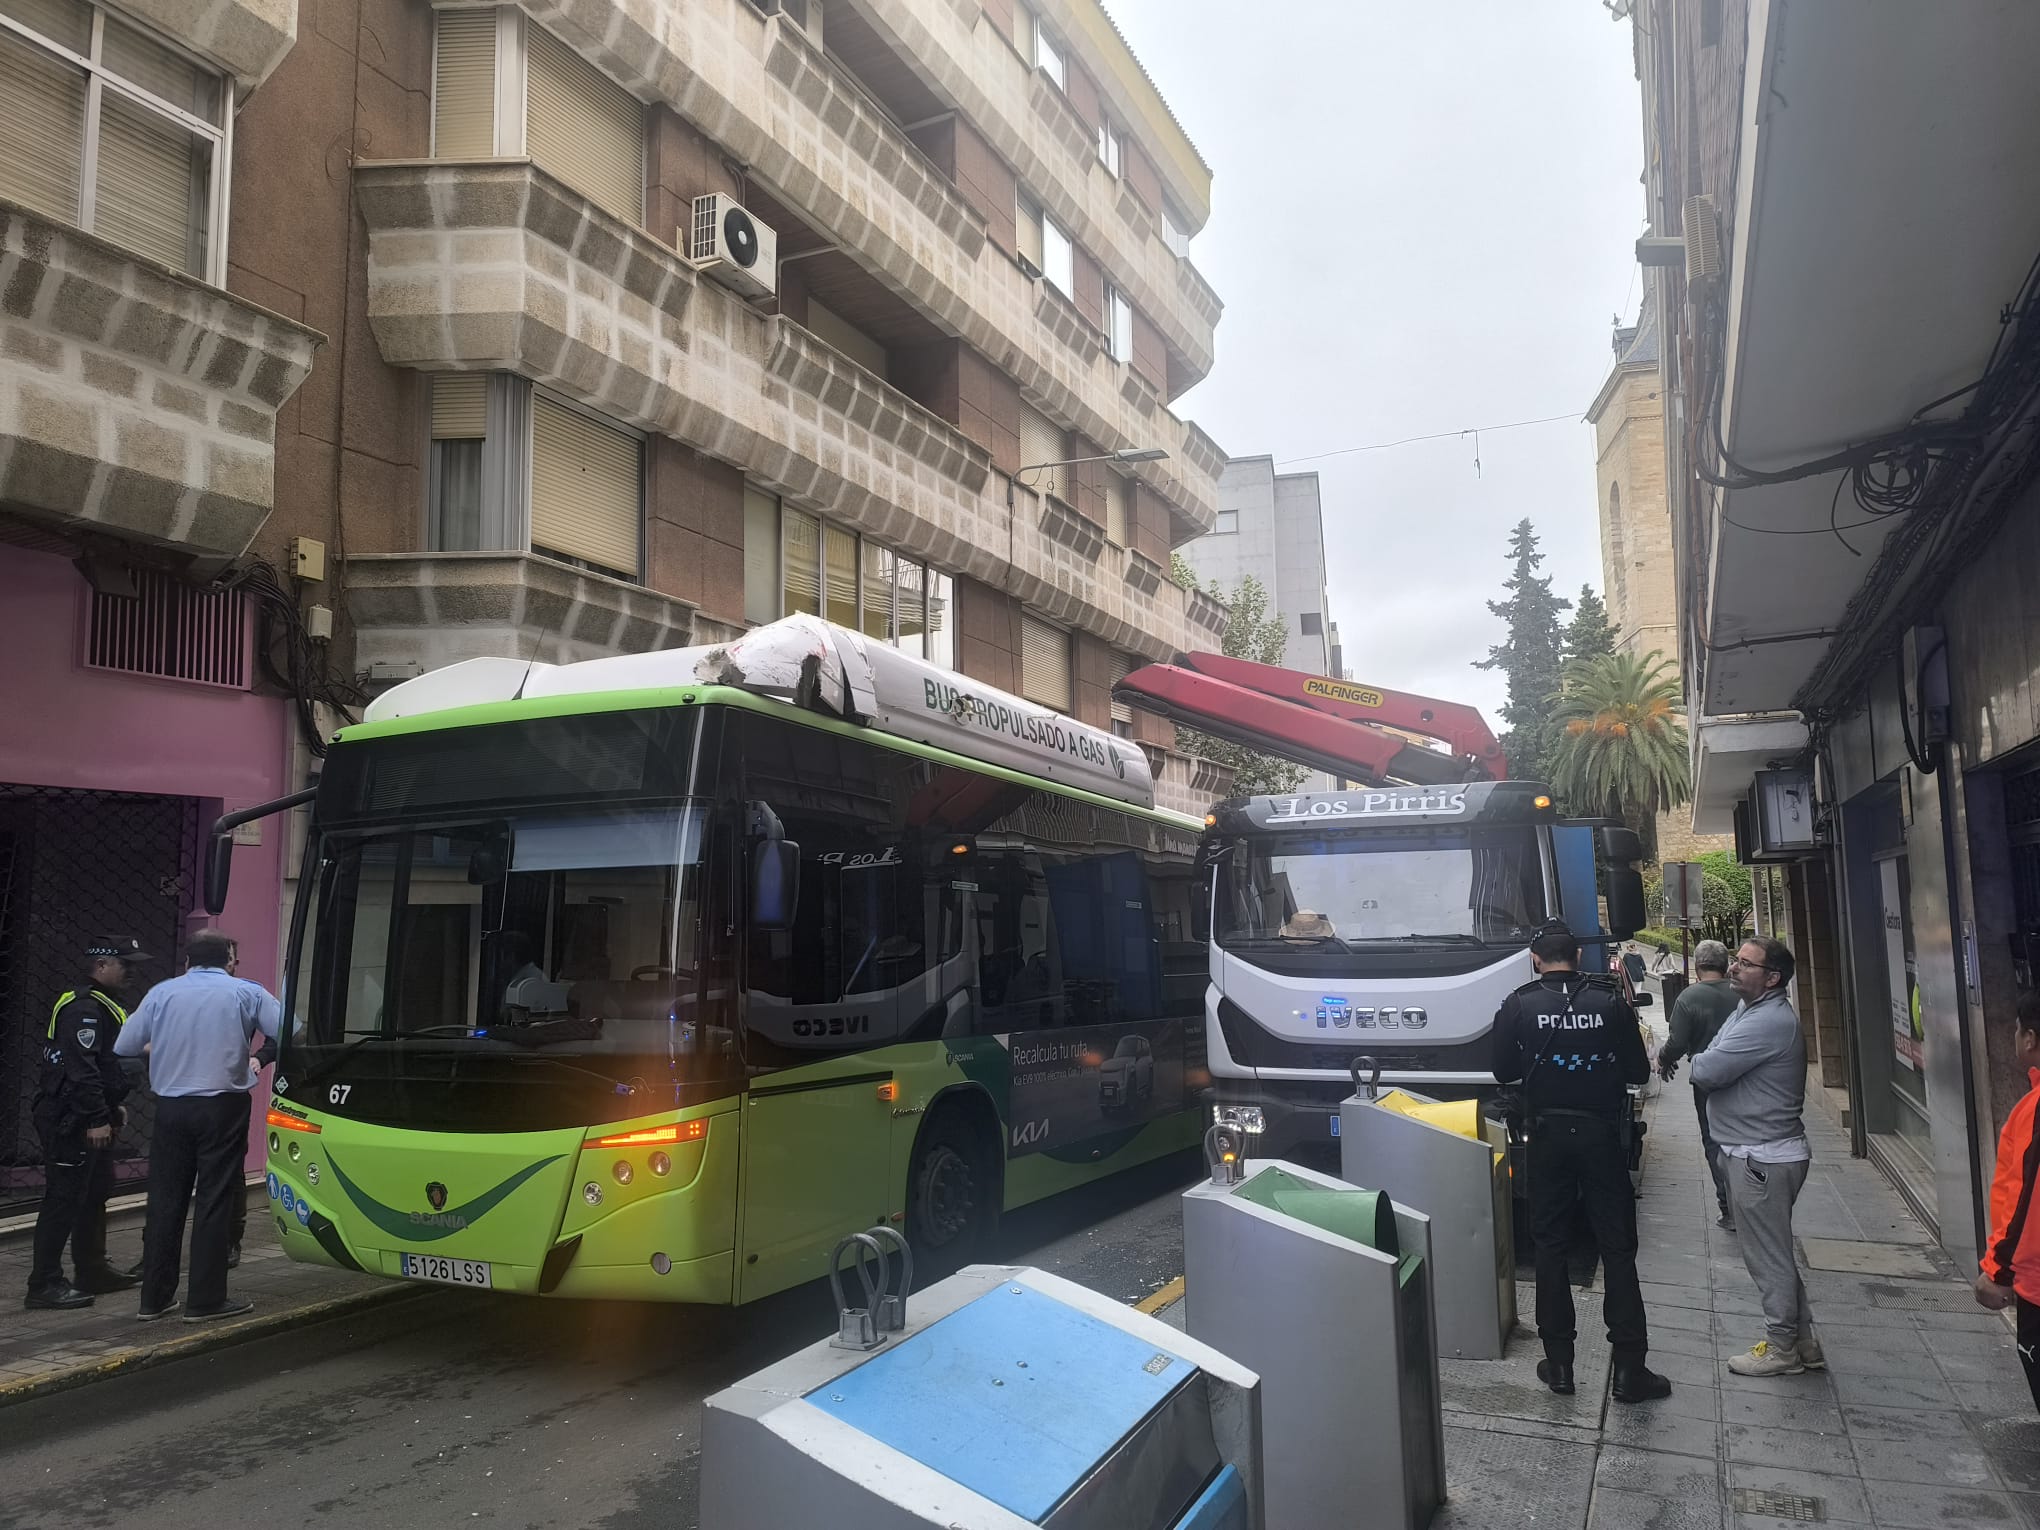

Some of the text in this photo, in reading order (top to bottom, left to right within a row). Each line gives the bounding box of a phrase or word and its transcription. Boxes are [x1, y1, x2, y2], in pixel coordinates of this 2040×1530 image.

[1307, 680, 1379, 705] PALFINGER
[1069, 732, 1078, 758] A
[1080, 736, 1105, 766] GAS
[1286, 791, 1466, 818] Los Pirris
[1316, 1006, 1428, 1029] IVECO
[1537, 1013, 1604, 1029] POLICIA
[1013, 1043, 1058, 1066] Recalcula
[1060, 1042, 1069, 1060] tu
[329, 1084, 352, 1105] 67
[410, 1211, 468, 1229] SCANIA
